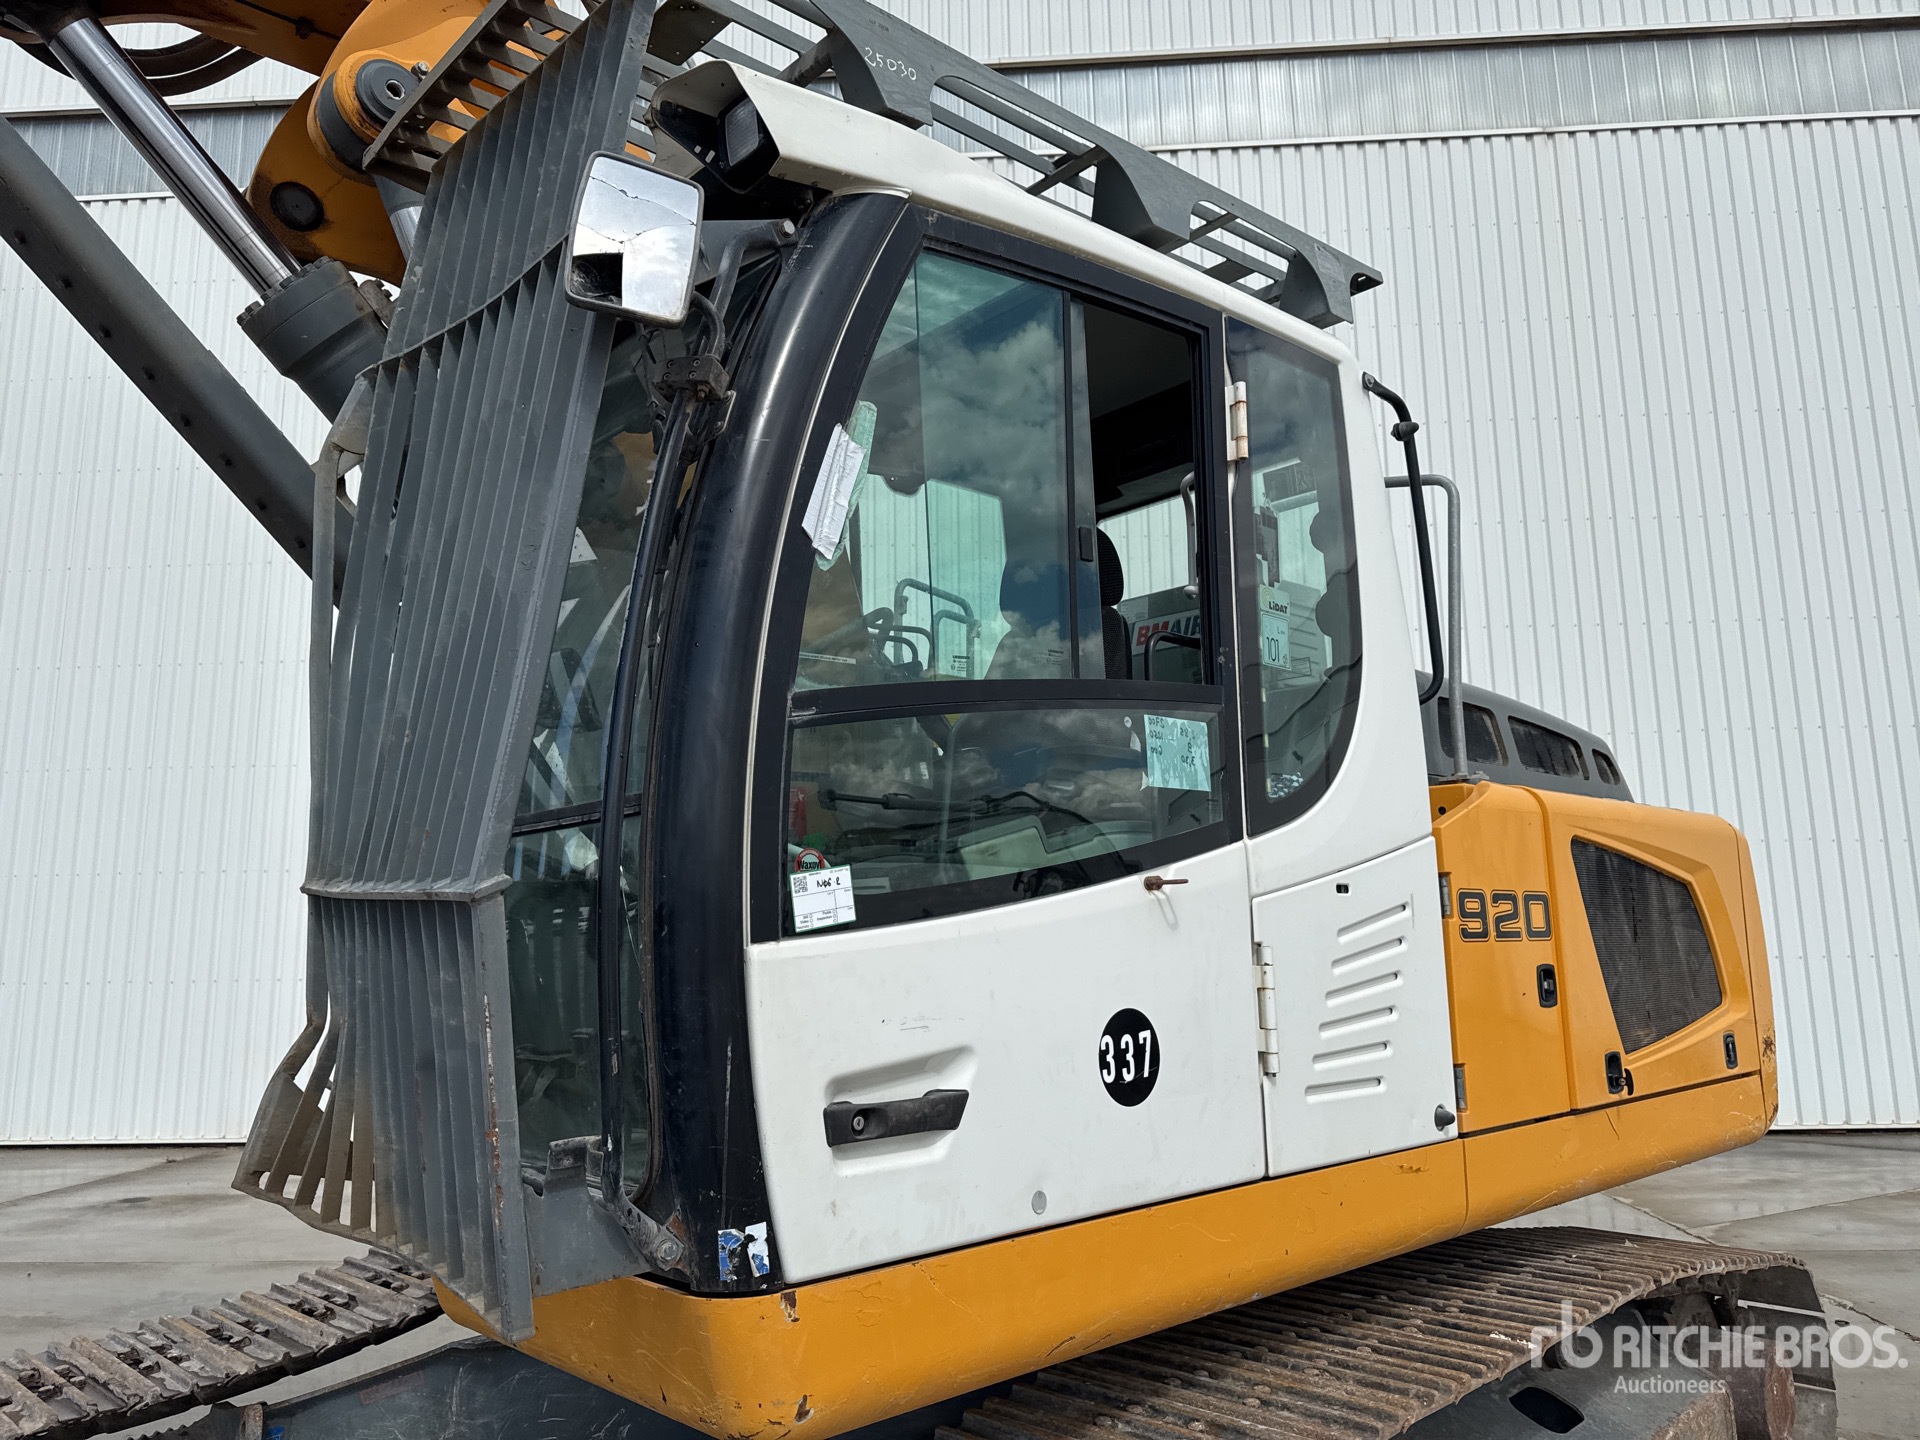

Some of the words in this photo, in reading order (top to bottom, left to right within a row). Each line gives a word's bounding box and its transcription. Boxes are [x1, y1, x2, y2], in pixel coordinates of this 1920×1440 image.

[864, 46, 917, 81] 25030
[1268, 600, 1288, 614] LiDAT
[1266, 636, 1280, 662] 101
[1457, 888, 1552, 942] 920
[1100, 1029, 1151, 1083] 337
